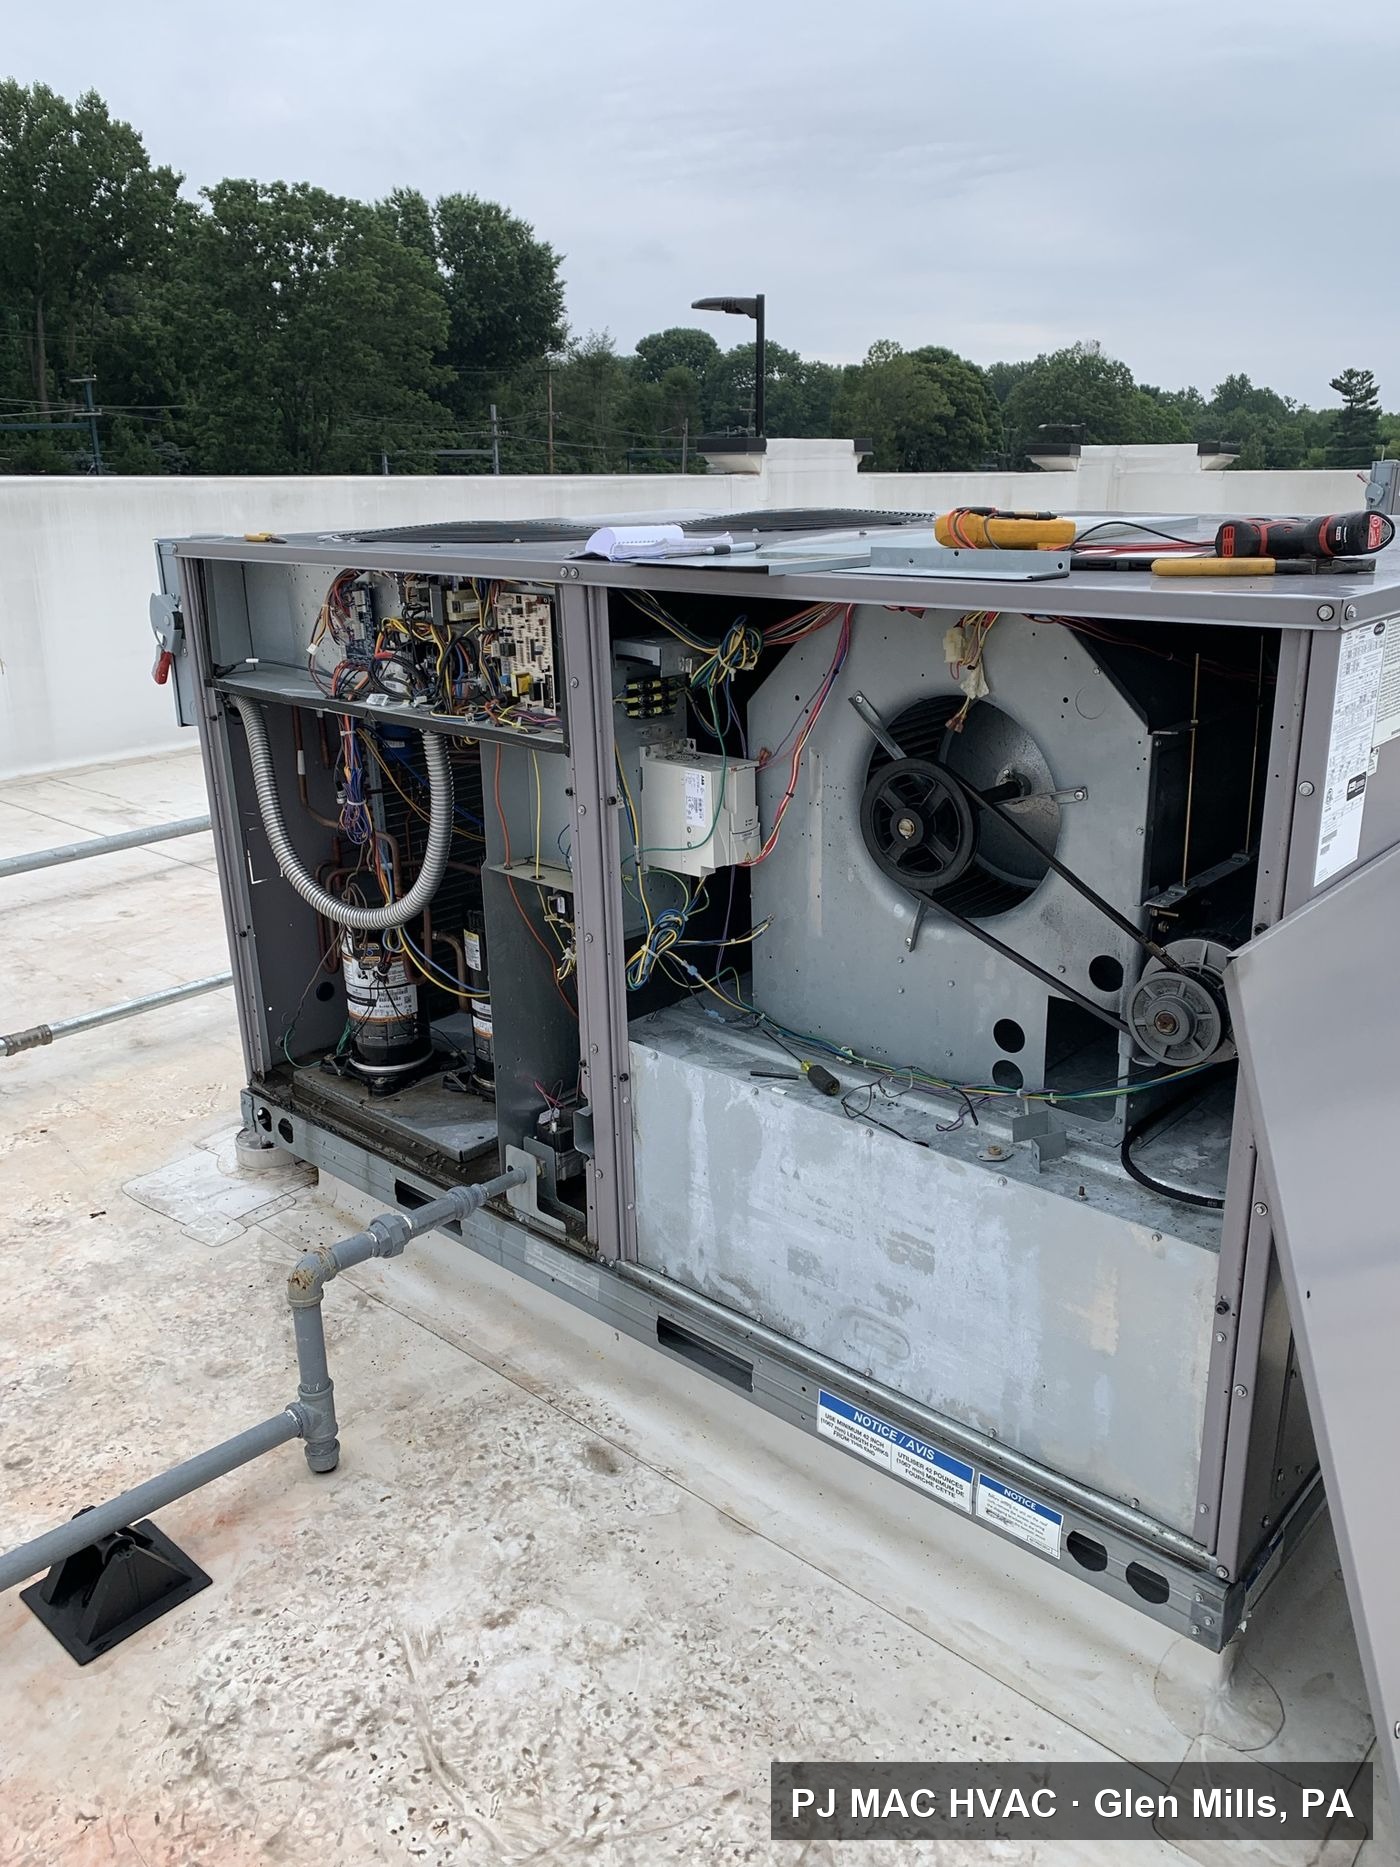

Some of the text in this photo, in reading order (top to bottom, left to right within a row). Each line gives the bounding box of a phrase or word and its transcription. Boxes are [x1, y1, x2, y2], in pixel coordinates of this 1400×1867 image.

[825, 1413, 835, 1422] USE
[837, 1419, 862, 1436] MINIMUM
[853, 1411, 935, 1460] NOTICE / AVIS
[897, 1452, 925, 1470] UTILISER
[905, 1469, 935, 1488] FOURCHE
[926, 1473, 954, 1493] MINIMUM
[1004, 1489, 1037, 1511] NOTICE
